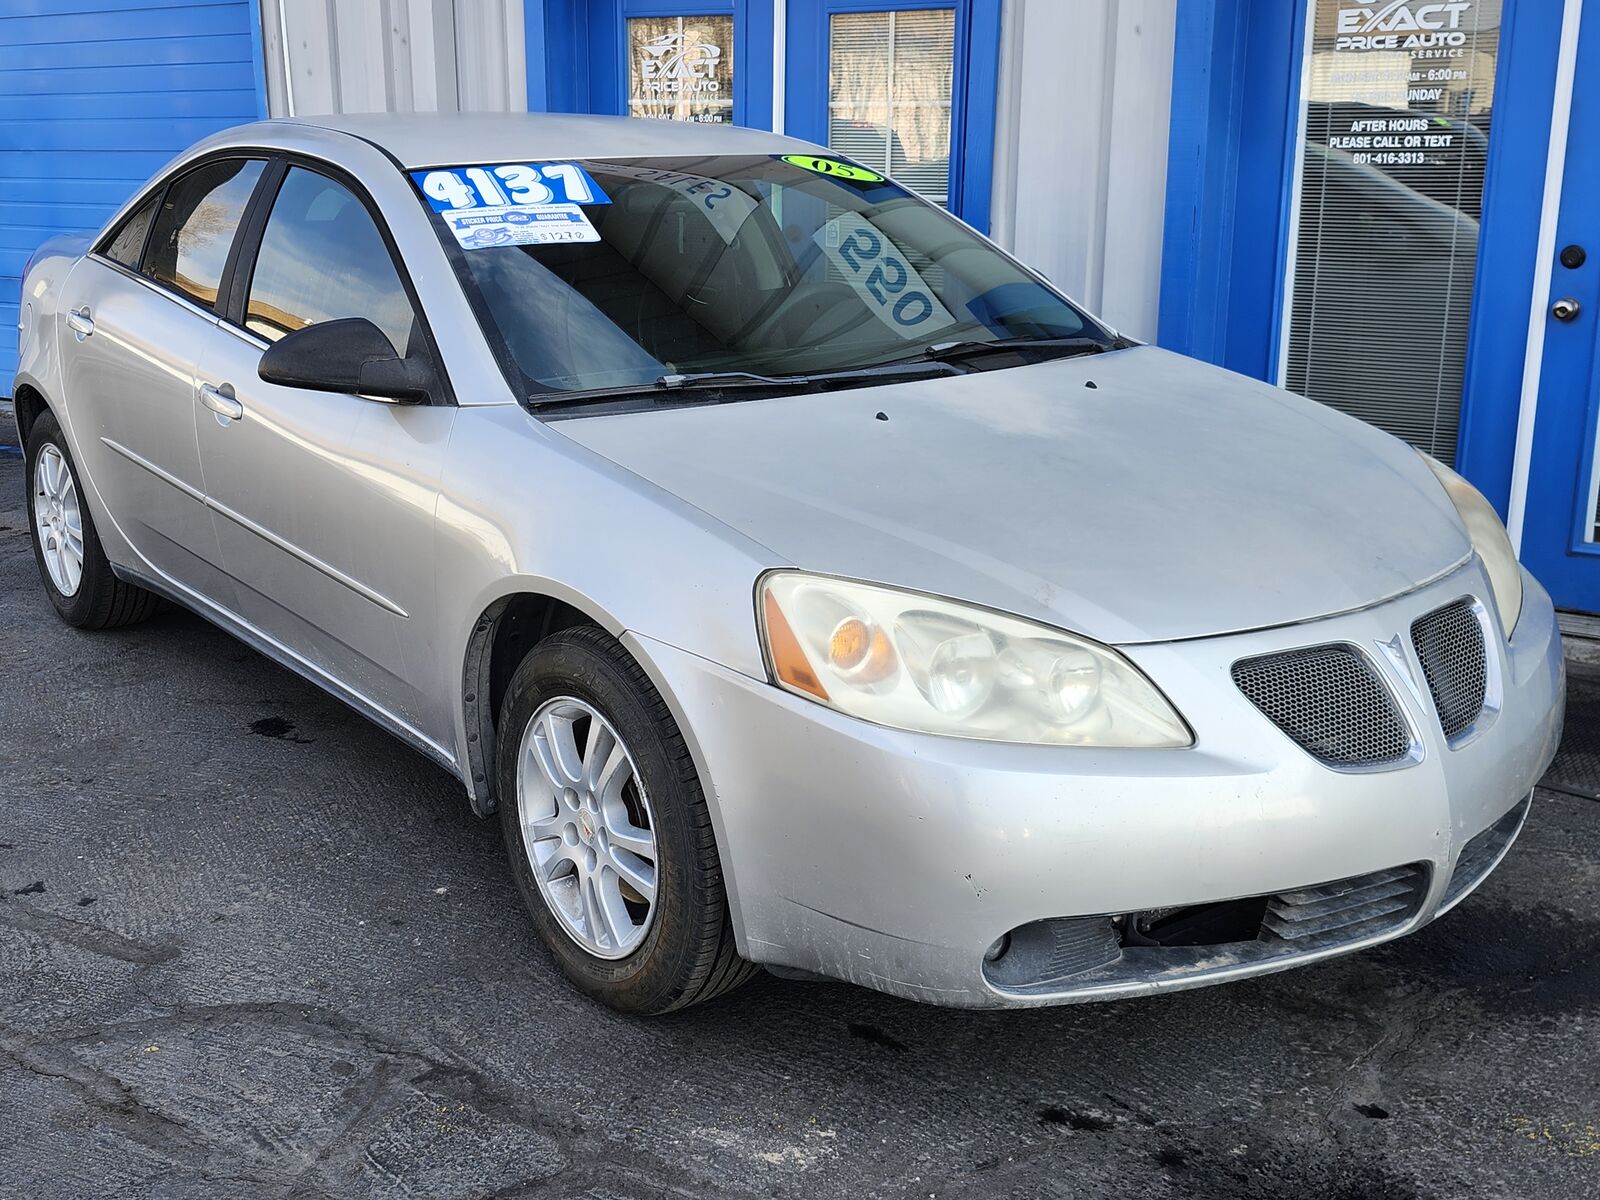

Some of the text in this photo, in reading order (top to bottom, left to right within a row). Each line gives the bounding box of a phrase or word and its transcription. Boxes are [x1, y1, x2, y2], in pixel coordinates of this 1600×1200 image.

[1337, 3, 1471, 33] EXACT
[1336, 32, 1466, 50] PRICE AUTO
[1410, 49, 1464, 59] SERVICE
[641, 58, 720, 79] EXACT
[1427, 69, 1451, 81] 6:00
[1452, 71, 1467, 80] PM
[642, 81, 719, 92] PRICE AUTO
[1403, 88, 1443, 101] UNDAY
[1351, 119, 1429, 132] AFTER HOURS
[1329, 135, 1453, 149] PLEASE CALL OR TEXT
[1353, 152, 1424, 164] 801-416-3313
[812, 160, 855, 178] 05
[423, 163, 595, 209] 4137
